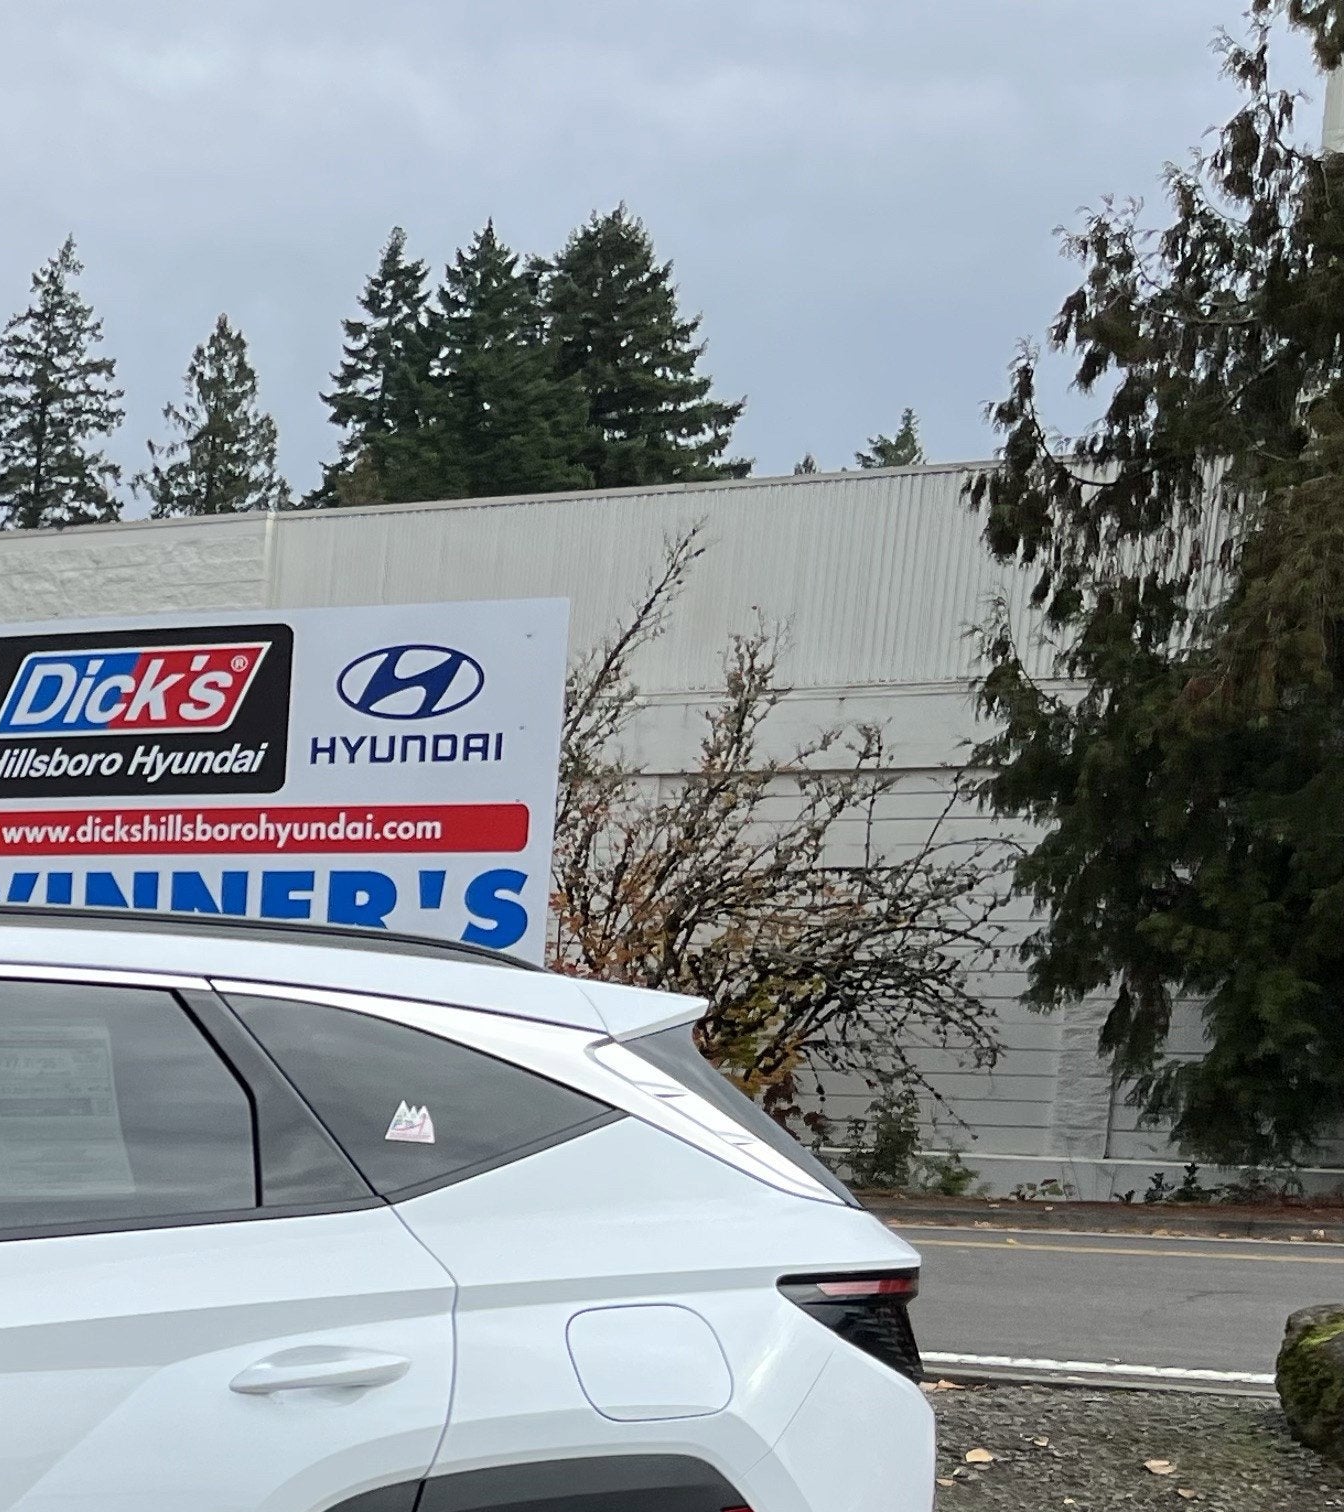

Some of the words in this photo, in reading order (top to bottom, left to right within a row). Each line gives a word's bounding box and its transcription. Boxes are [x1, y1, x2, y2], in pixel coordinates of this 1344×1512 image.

[127, 742, 269, 783] Hyundai
[310, 732, 503, 765] HYUNDAI
[1, 813, 442, 846] www.dickshillsborohyundai.com
